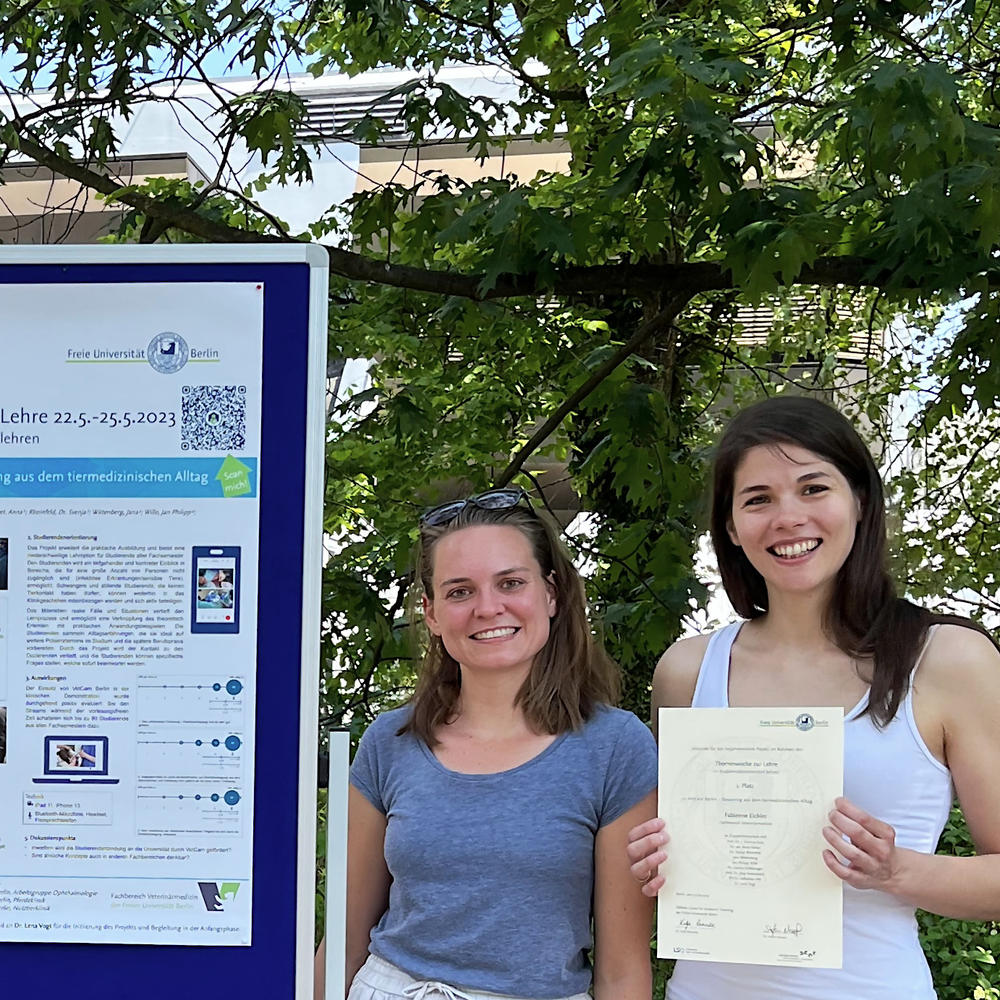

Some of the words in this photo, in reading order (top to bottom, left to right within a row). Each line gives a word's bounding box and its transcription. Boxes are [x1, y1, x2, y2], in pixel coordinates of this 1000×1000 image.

[67, 349, 91, 358] Freie
[93, 348, 145, 358] Universität
[190, 348, 218, 358] Berlin
[1, 407, 48, 424] Lehre
[53, 411, 177, 428] 22.5.-25.5.2023
[0, 431, 40, 444] lehren
[14, 473, 34, 482] aus
[38, 470, 64, 482] dem
[67, 470, 172, 482] tiermedizinischen
[174, 470, 209, 486] Alltag
[224, 470, 244, 480] Scan
[225, 479, 249, 492] mich!
